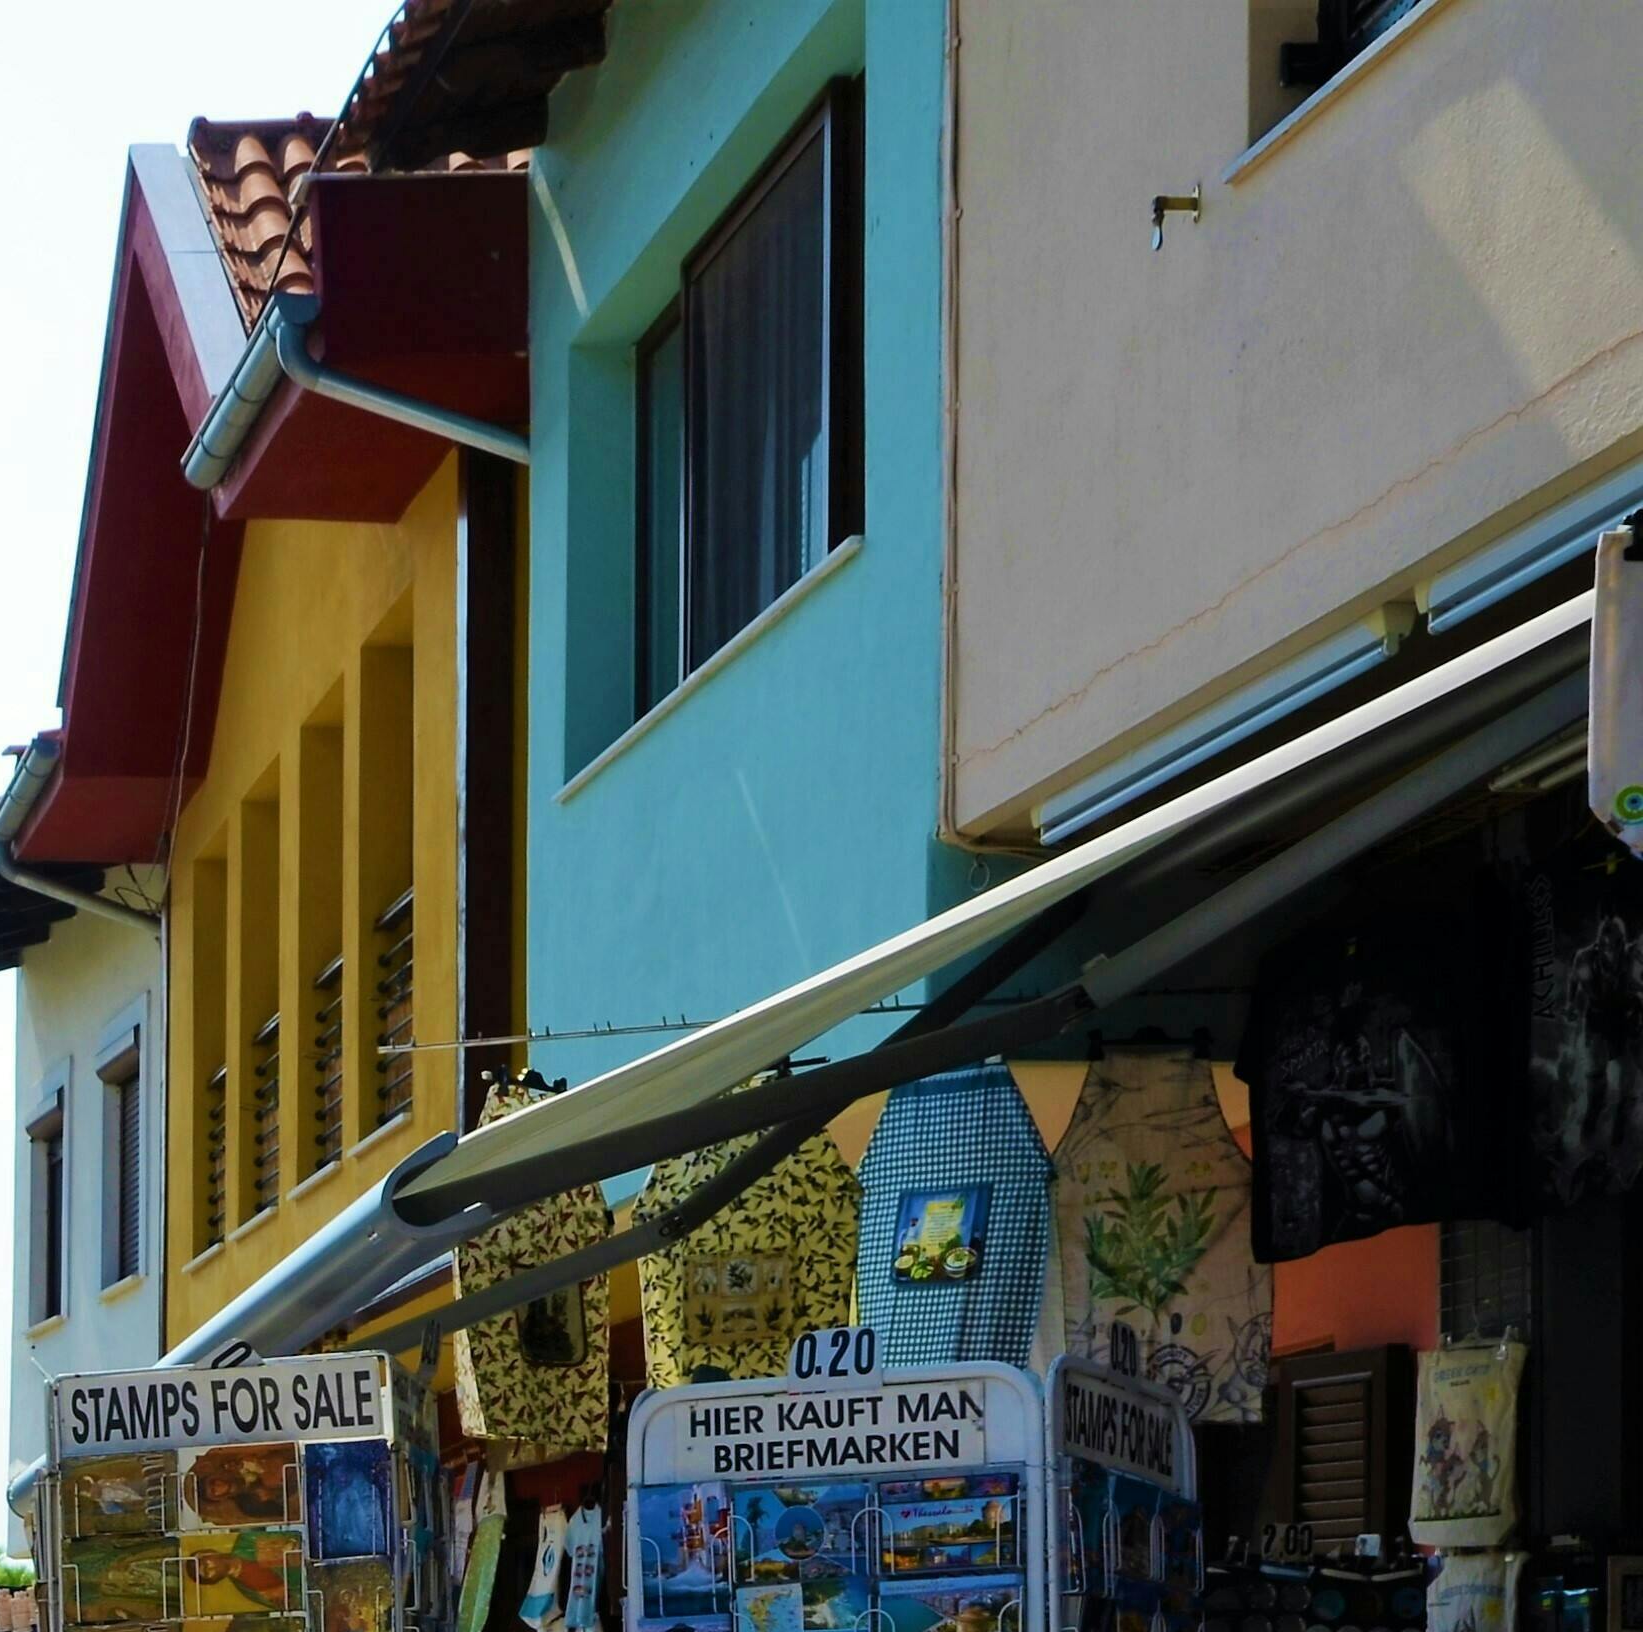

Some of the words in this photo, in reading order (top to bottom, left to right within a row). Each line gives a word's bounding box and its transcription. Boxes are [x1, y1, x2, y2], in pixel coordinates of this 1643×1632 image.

[795, 1328, 876, 1379] 0.20
[71, 1381, 200, 1445] STAMPS
[211, 1376, 283, 1434] FOR
[293, 1370, 375, 1431] SALE
[689, 1404, 764, 1438] HIER
[778, 1396, 883, 1432] KAUFT
[898, 1390, 984, 1424] MAN
[1064, 1383, 1117, 1456] STAMPS
[1120, 1401, 1145, 1466] FOR
[1148, 1411, 1172, 1477] SALE
[714, 1429, 960, 1473] BRIEFMARKEN
